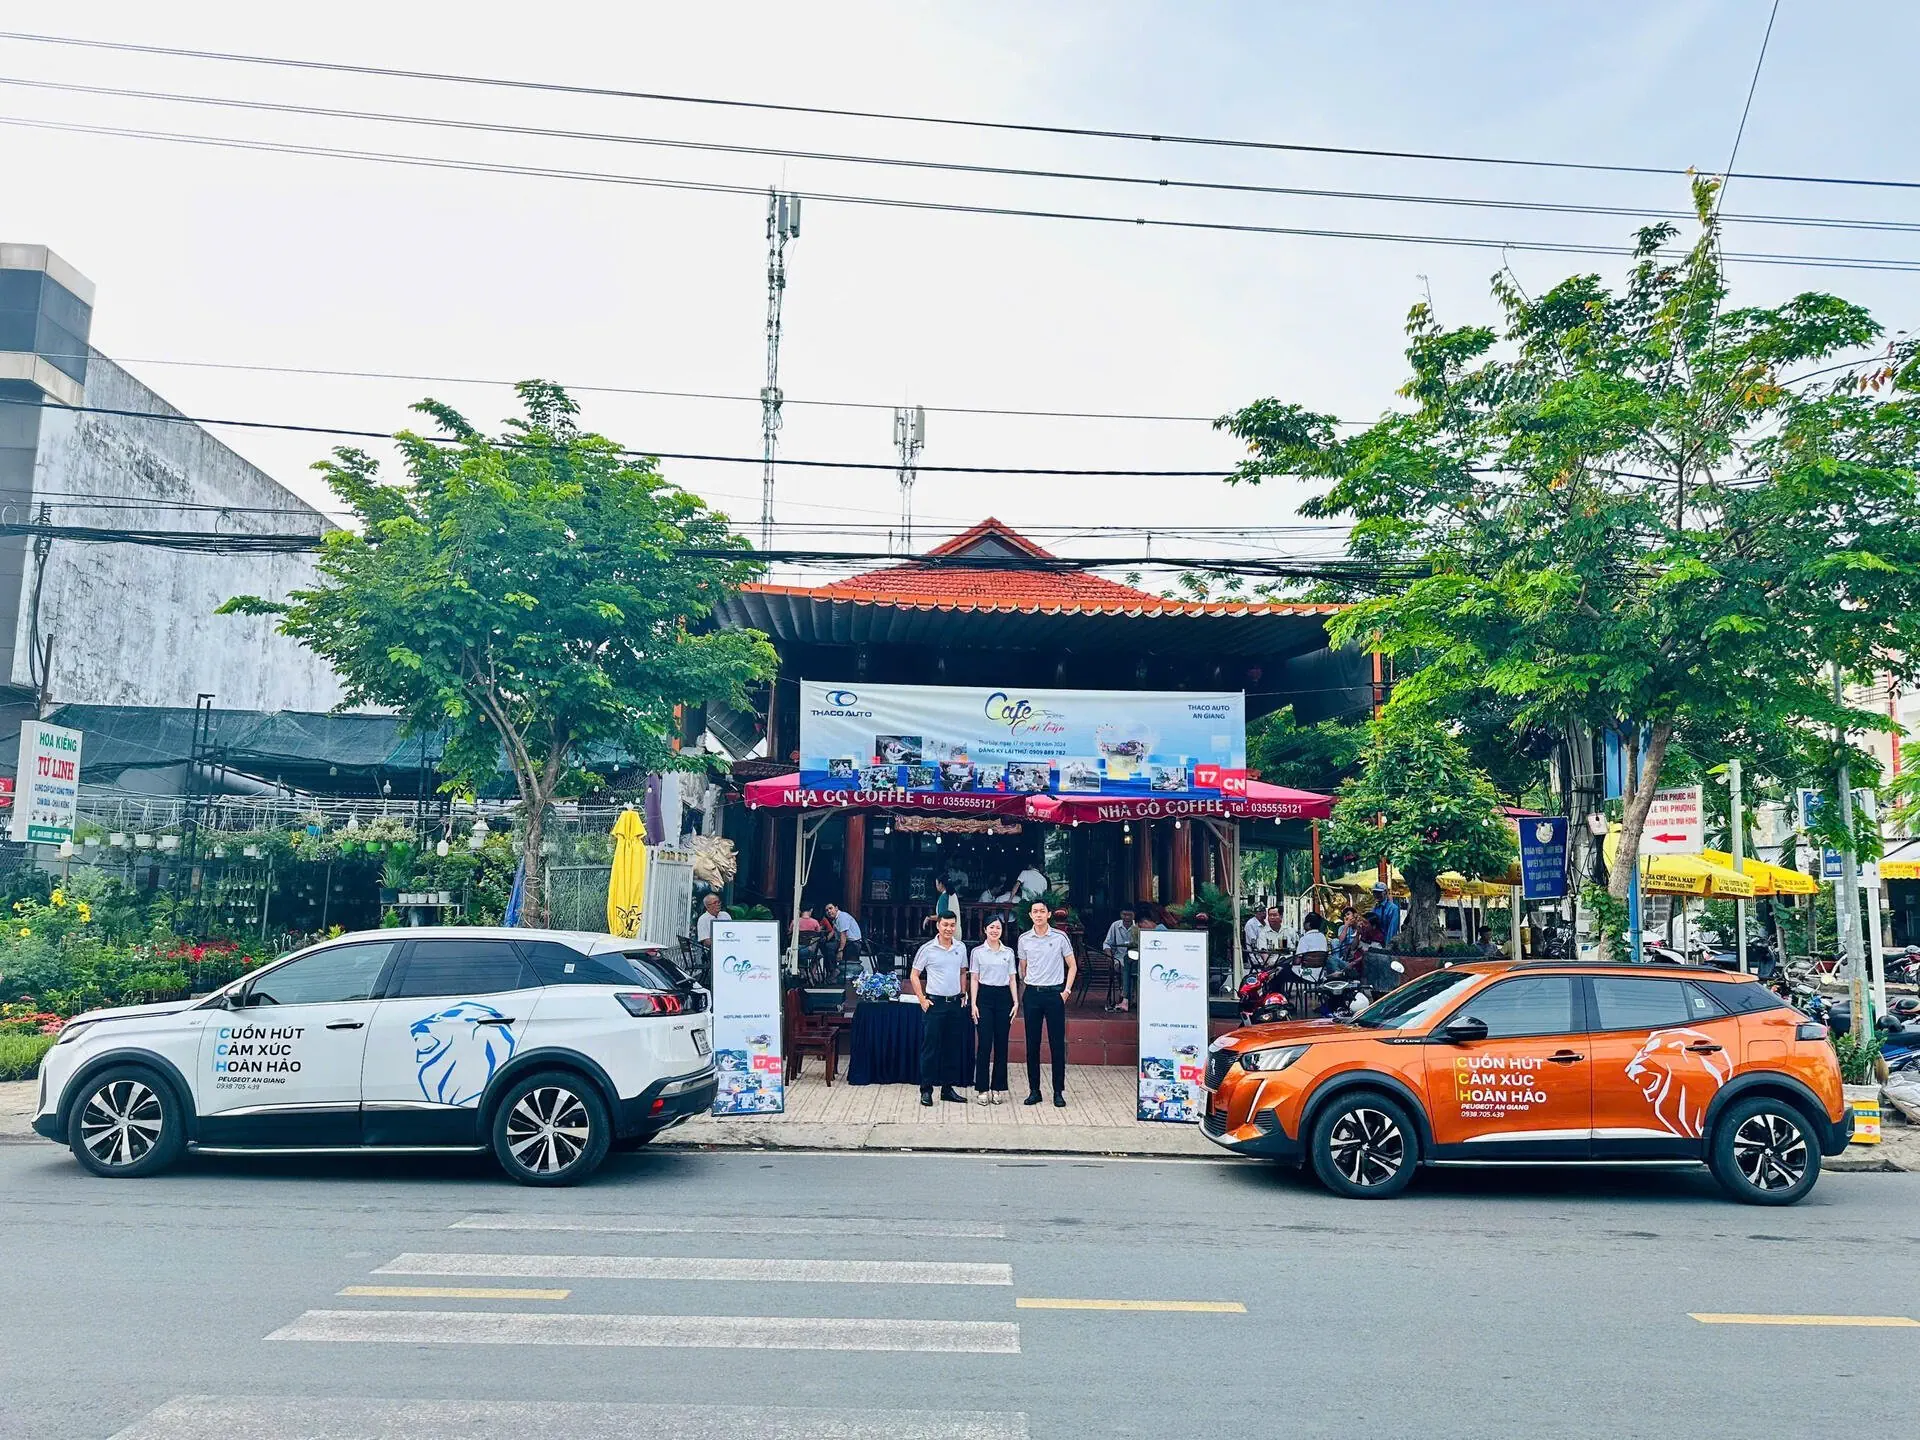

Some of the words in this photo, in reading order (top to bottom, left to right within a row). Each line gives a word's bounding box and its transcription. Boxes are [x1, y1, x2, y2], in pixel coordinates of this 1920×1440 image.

[40, 732, 54, 748] HOA
[52, 759, 75, 781] LINH
[1198, 771, 1217, 783] T7
[1223, 778, 1246, 790] CN
[854, 790, 915, 803] COFFEE
[922, 795, 935, 805] Tel
[943, 796, 996, 808] 0355555121
[1098, 801, 1131, 819] NHÀ
[1165, 800, 1224, 814] COFFEE
[1231, 803, 1244, 812] Tel
[1251, 803, 1302, 813] 0355555121
[220, 1024, 266, 1039] CUỐN
[270, 1026, 305, 1039] HÚT
[217, 1041, 253, 1055] CẢM
[257, 1042, 291, 1055] XÚC
[216, 1059, 262, 1072] HOÀN
[267, 1058, 301, 1072] HẢO
[1456, 1053, 1505, 1069] CUỐN
[1510, 1056, 1544, 1070] HÚT
[1458, 1070, 1496, 1085] CẢM
[1500, 1072, 1535, 1086] XÚC
[1460, 1088, 1507, 1102] HOÀN
[1511, 1088, 1547, 1103] HẢO
